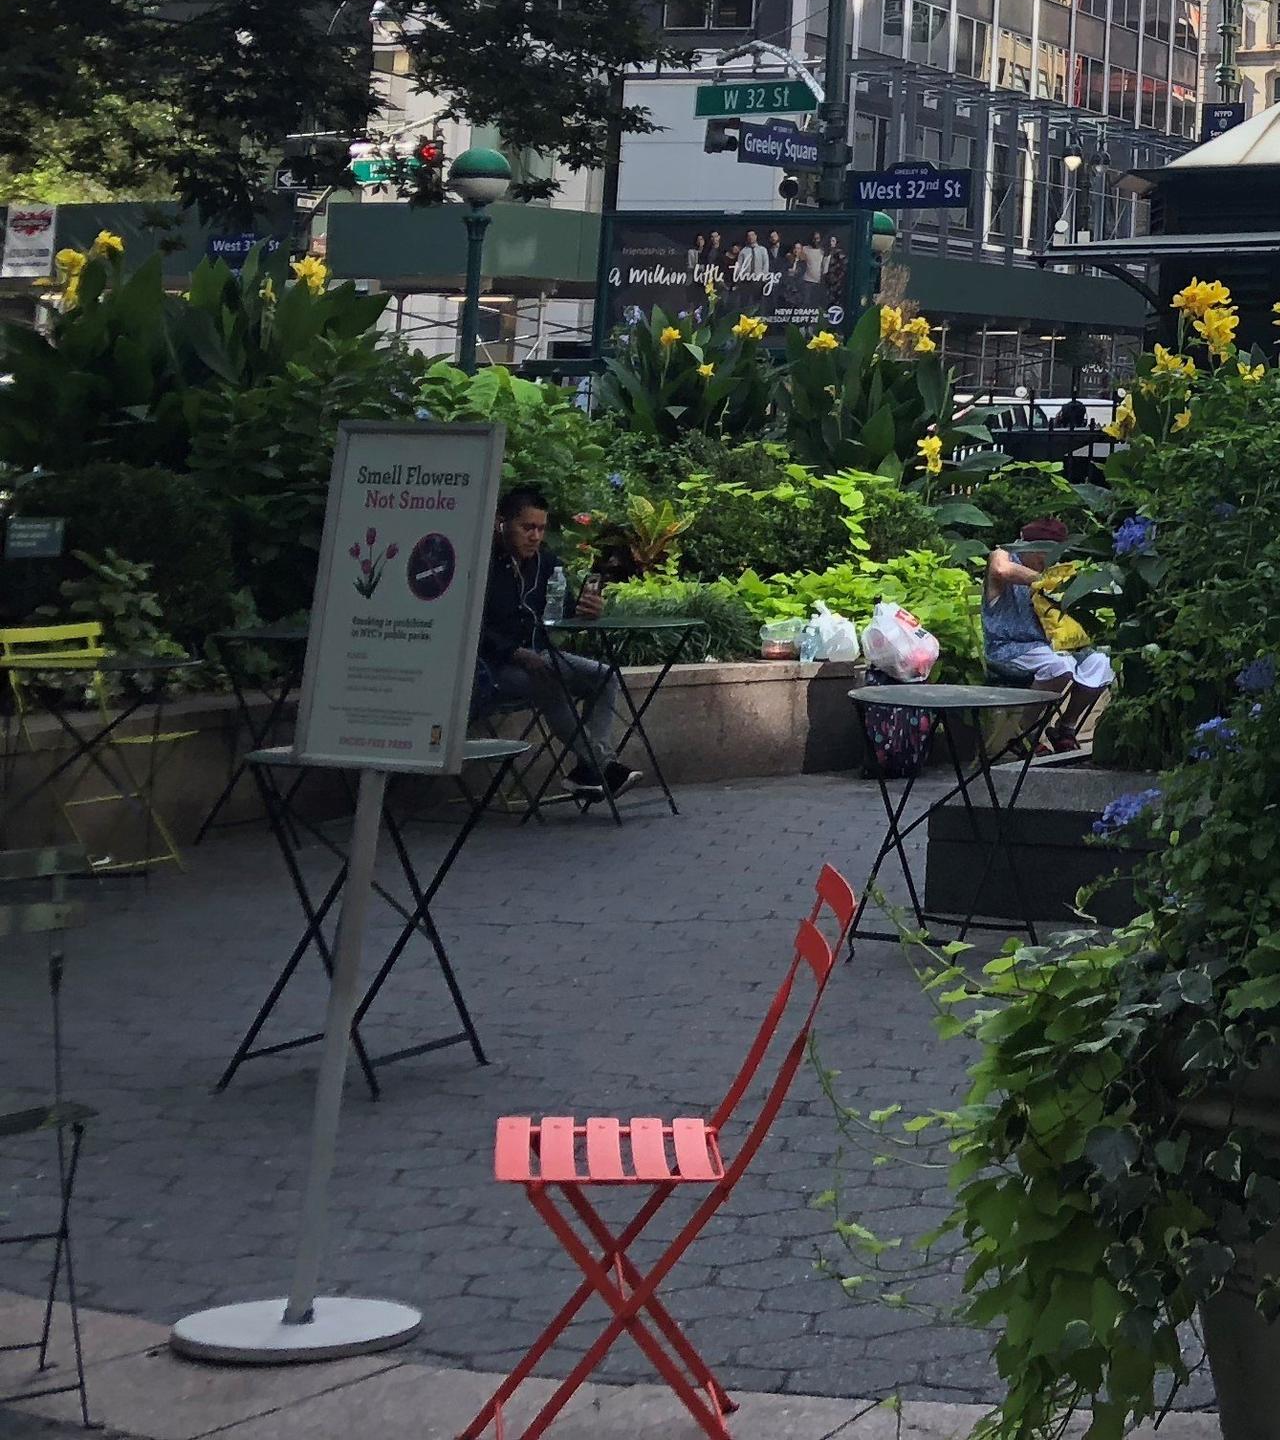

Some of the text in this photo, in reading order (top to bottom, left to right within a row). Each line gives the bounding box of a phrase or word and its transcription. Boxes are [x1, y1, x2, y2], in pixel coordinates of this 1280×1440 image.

[724, 88, 790, 110] W 32 St
[744, 133, 818, 163] Greeley Square
[859, 179, 961, 200] West 32nd St
[213, 240, 241, 252] West
[268, 240, 280, 251] St
[608, 267, 622, 287] a
[629, 263, 687, 286] million
[728, 254, 782, 296] things
[774, 308, 820, 316] NEW DRAMA
[357, 464, 470, 487] Smell Flowers
[365, 490, 457, 510] Not Smoke
